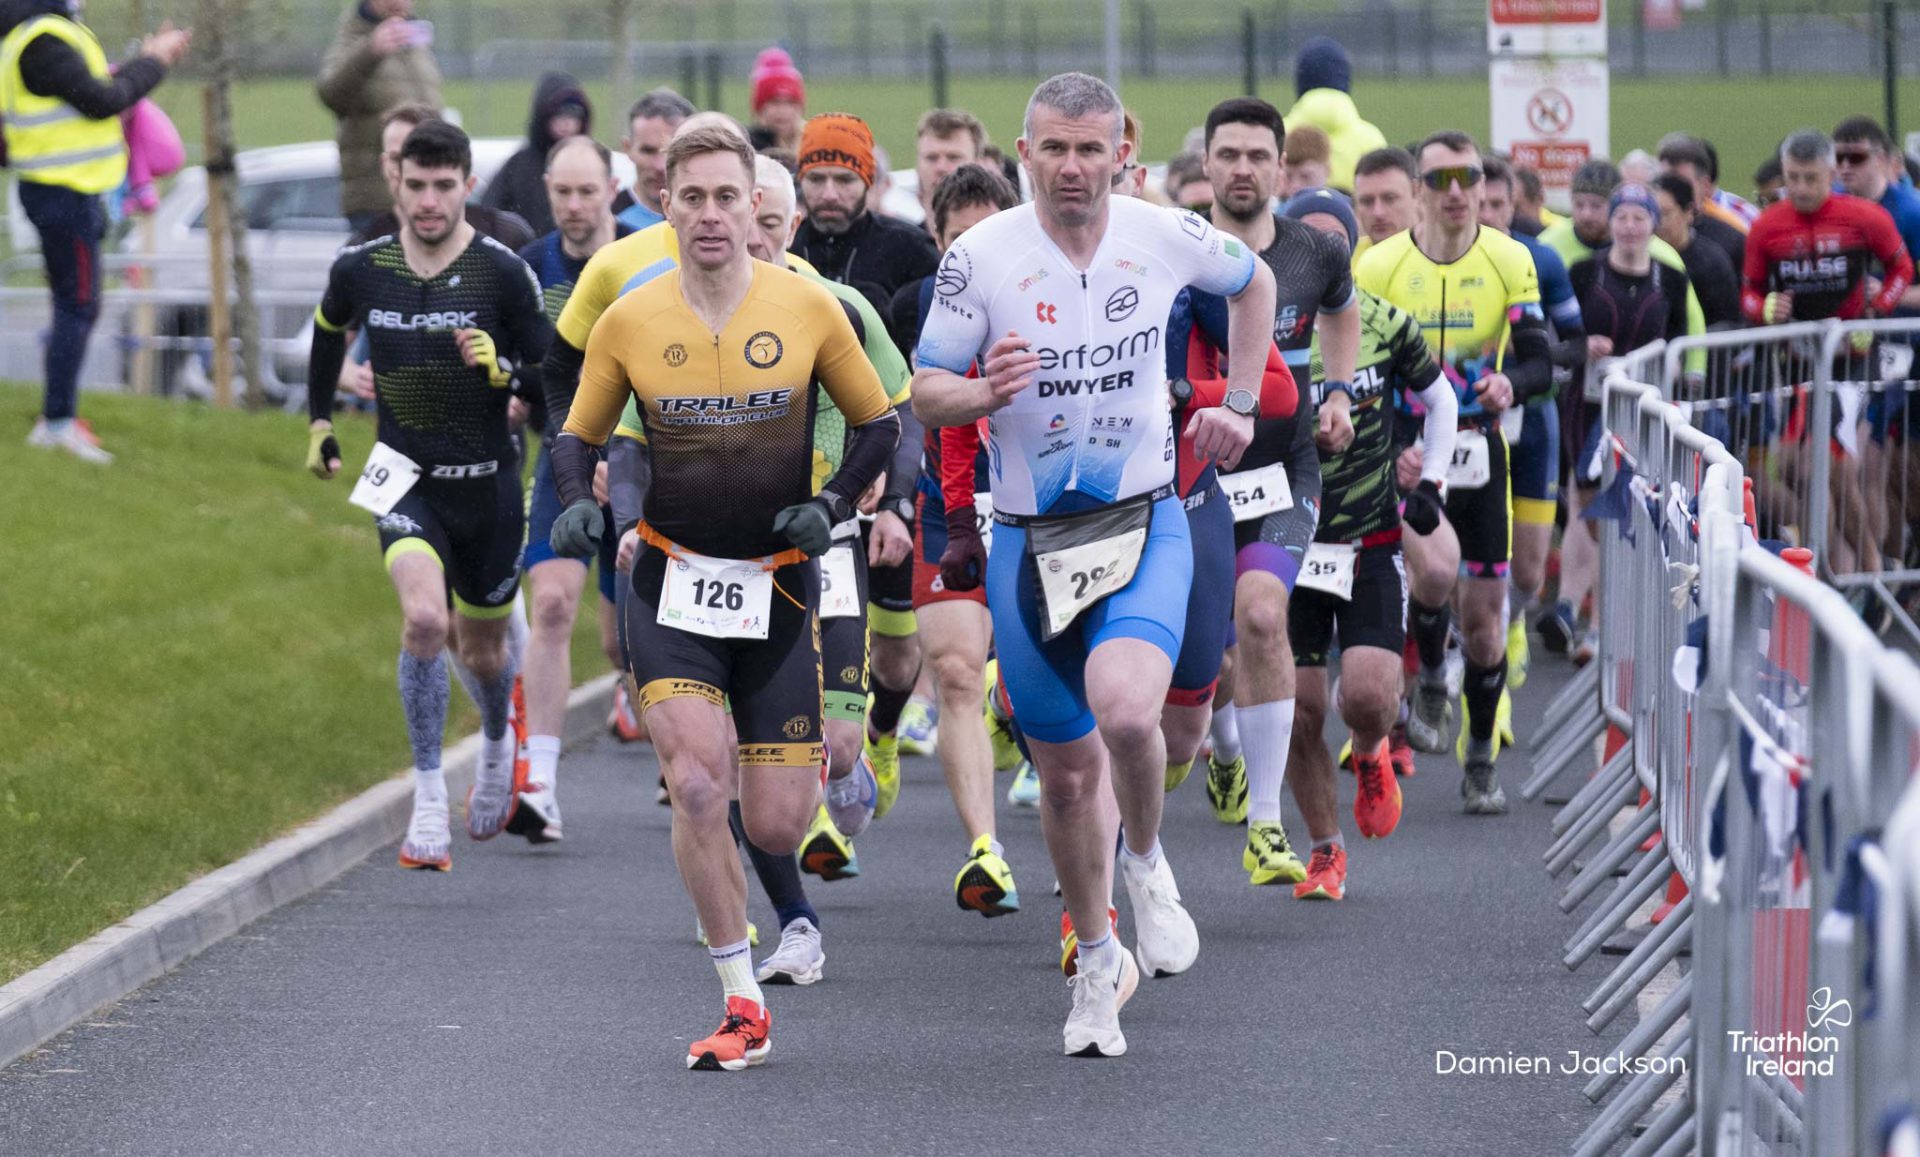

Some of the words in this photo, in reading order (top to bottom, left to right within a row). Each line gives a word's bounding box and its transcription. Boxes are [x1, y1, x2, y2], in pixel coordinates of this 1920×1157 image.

[1779, 256, 1848, 280] PULSE
[367, 308, 478, 330] BELPARK
[1014, 326, 1159, 370] erform
[1038, 370, 1135, 398] DWYER
[655, 387, 794, 415] TRALEE
[692, 578, 744, 612] 126
